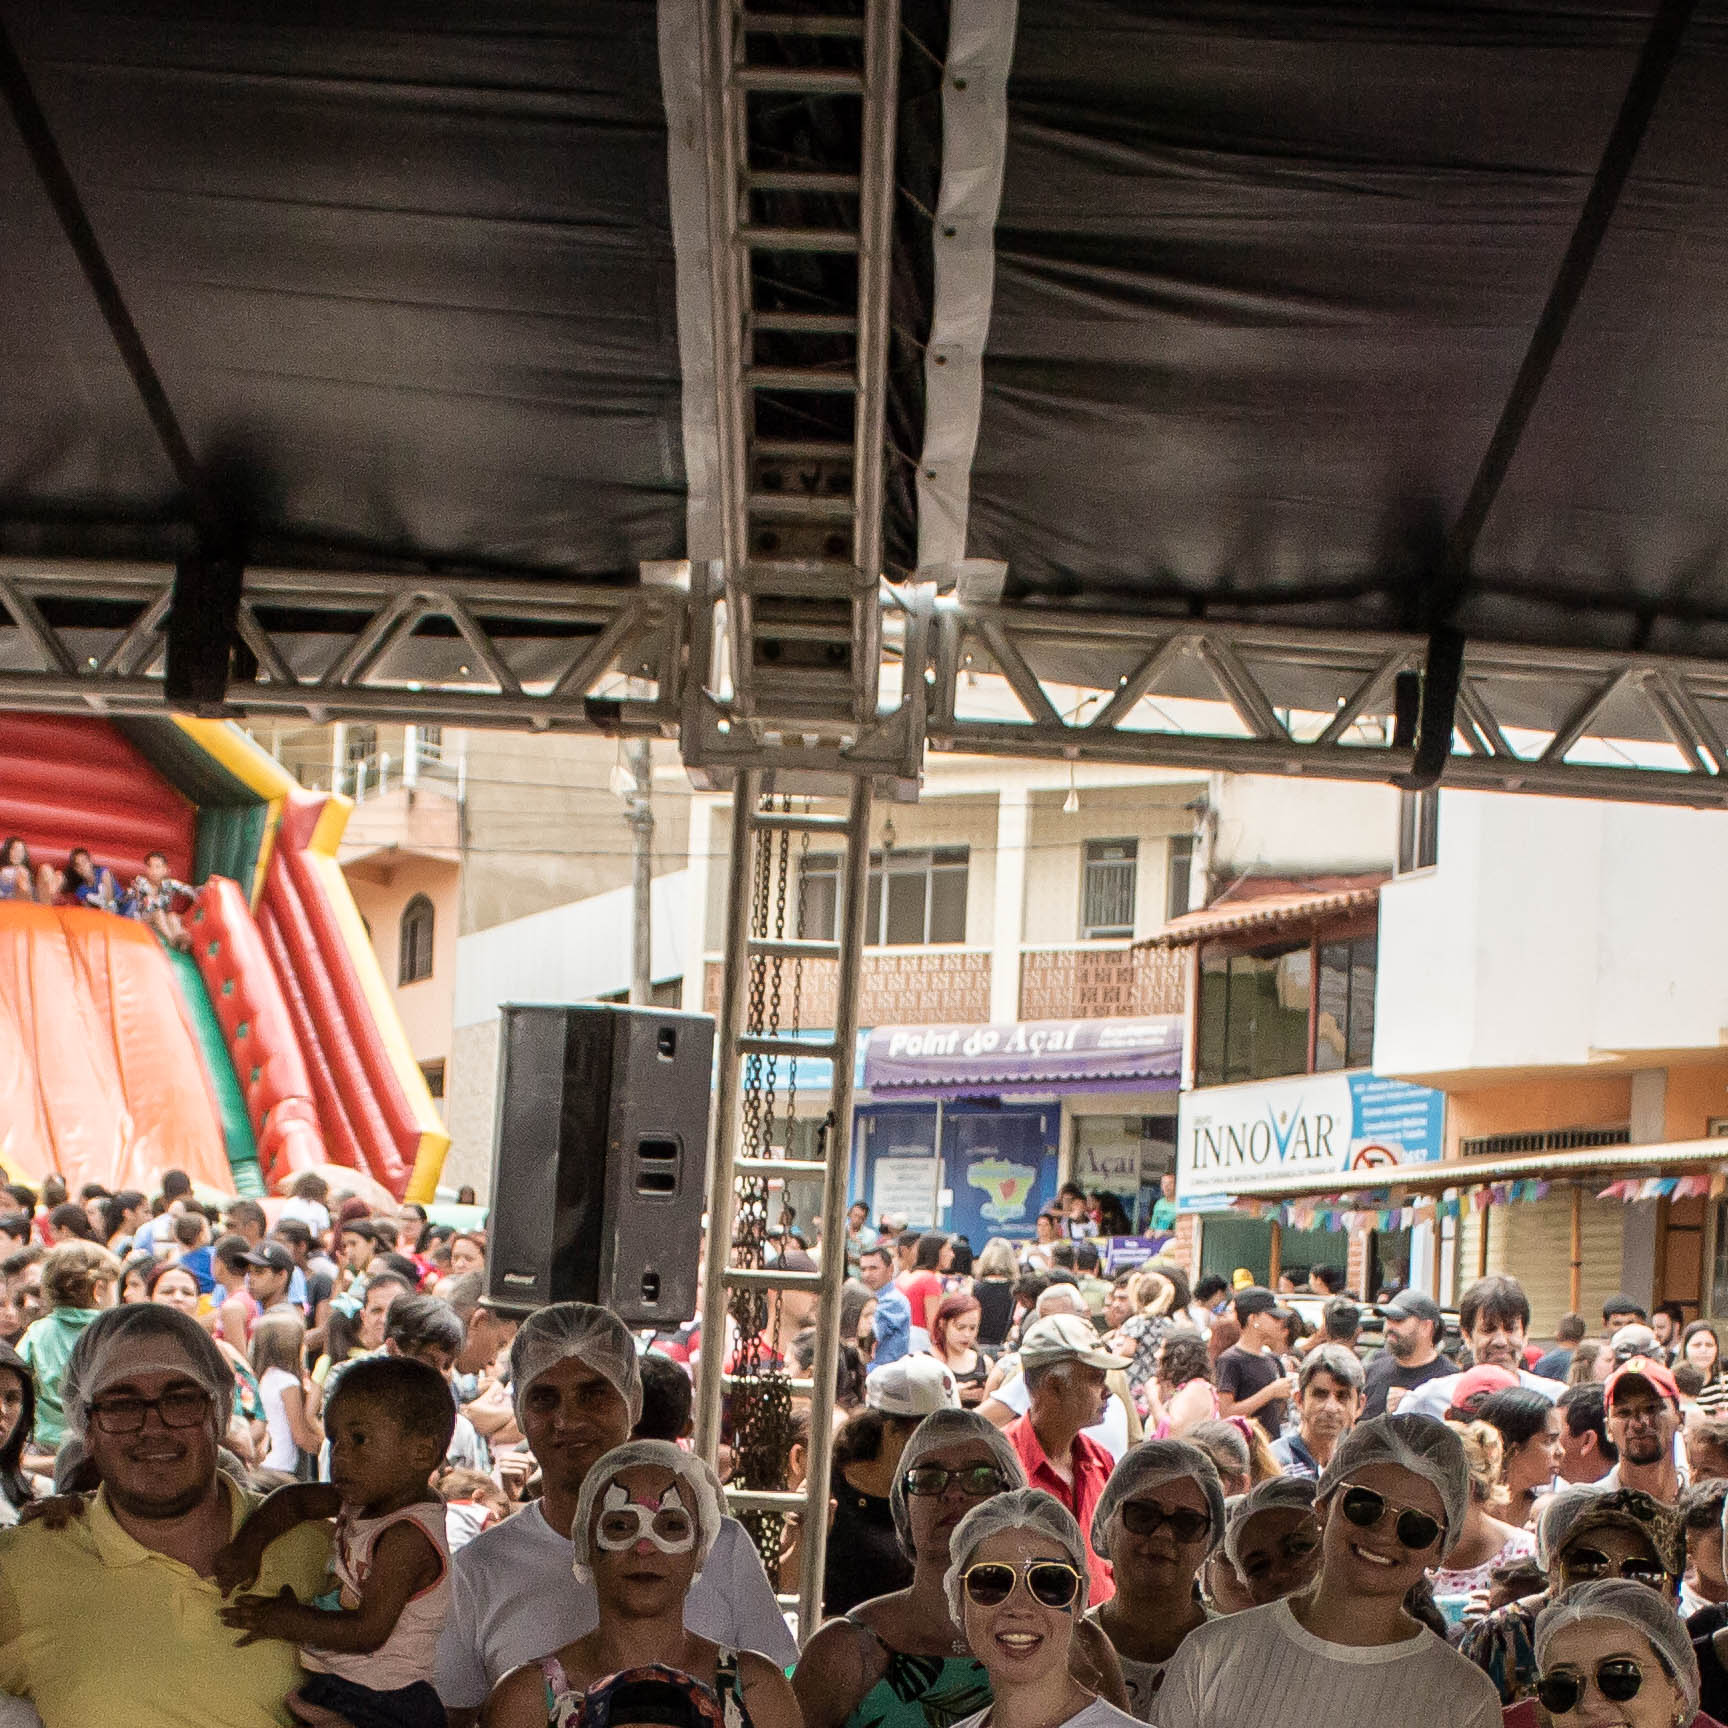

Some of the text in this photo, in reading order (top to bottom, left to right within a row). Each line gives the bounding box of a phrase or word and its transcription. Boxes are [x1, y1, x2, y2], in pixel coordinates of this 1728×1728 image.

[888, 1030, 960, 1057] Point
[962, 1029, 1001, 1057] do
[1003, 1022, 1082, 1058] Açaí
[1191, 1097, 1335, 1169] INNOVAR
